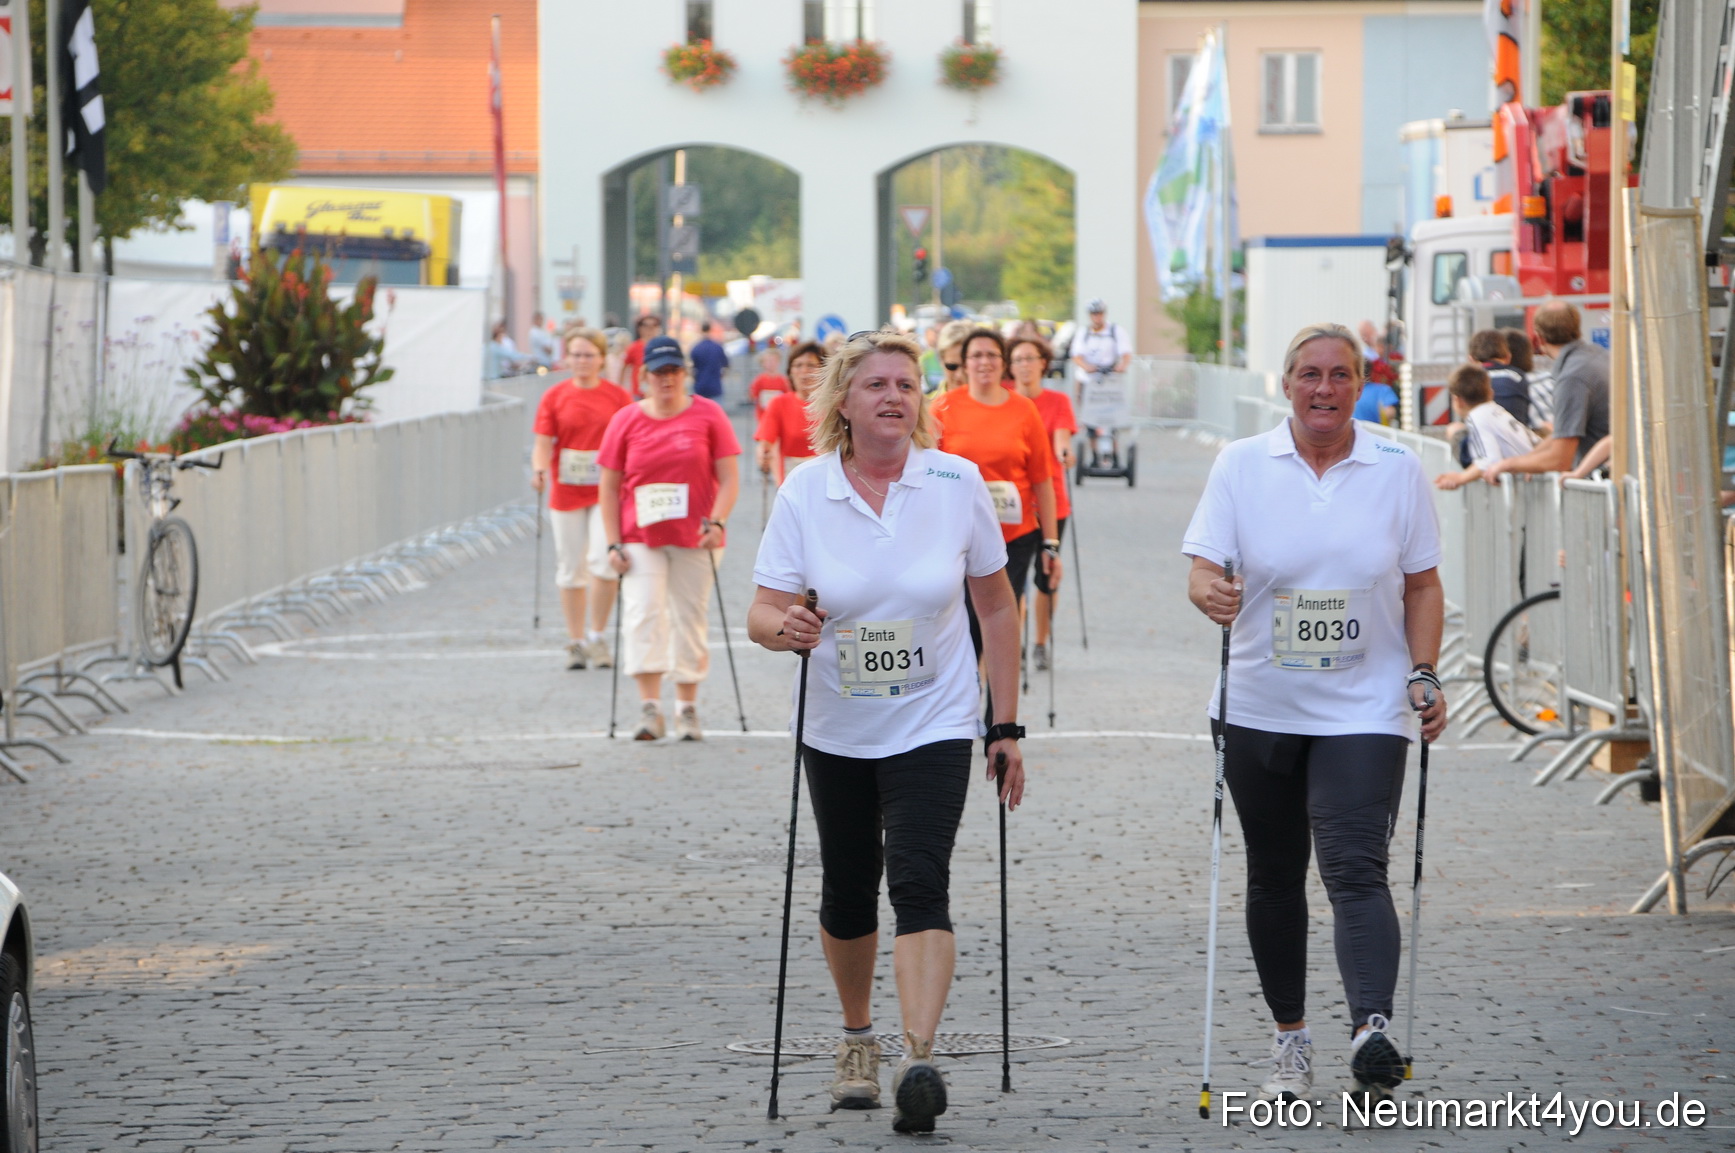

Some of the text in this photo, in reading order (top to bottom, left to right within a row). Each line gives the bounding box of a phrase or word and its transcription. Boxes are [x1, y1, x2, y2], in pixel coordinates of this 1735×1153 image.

[937, 470, 961, 480] DEKRA
[1297, 594, 1345, 611] Annette
[1275, 616, 1281, 628] N
[860, 627, 896, 642] Zenta
[1298, 619, 1360, 641] 8030
[840, 650, 847, 661] N
[864, 646, 924, 672] 8031
